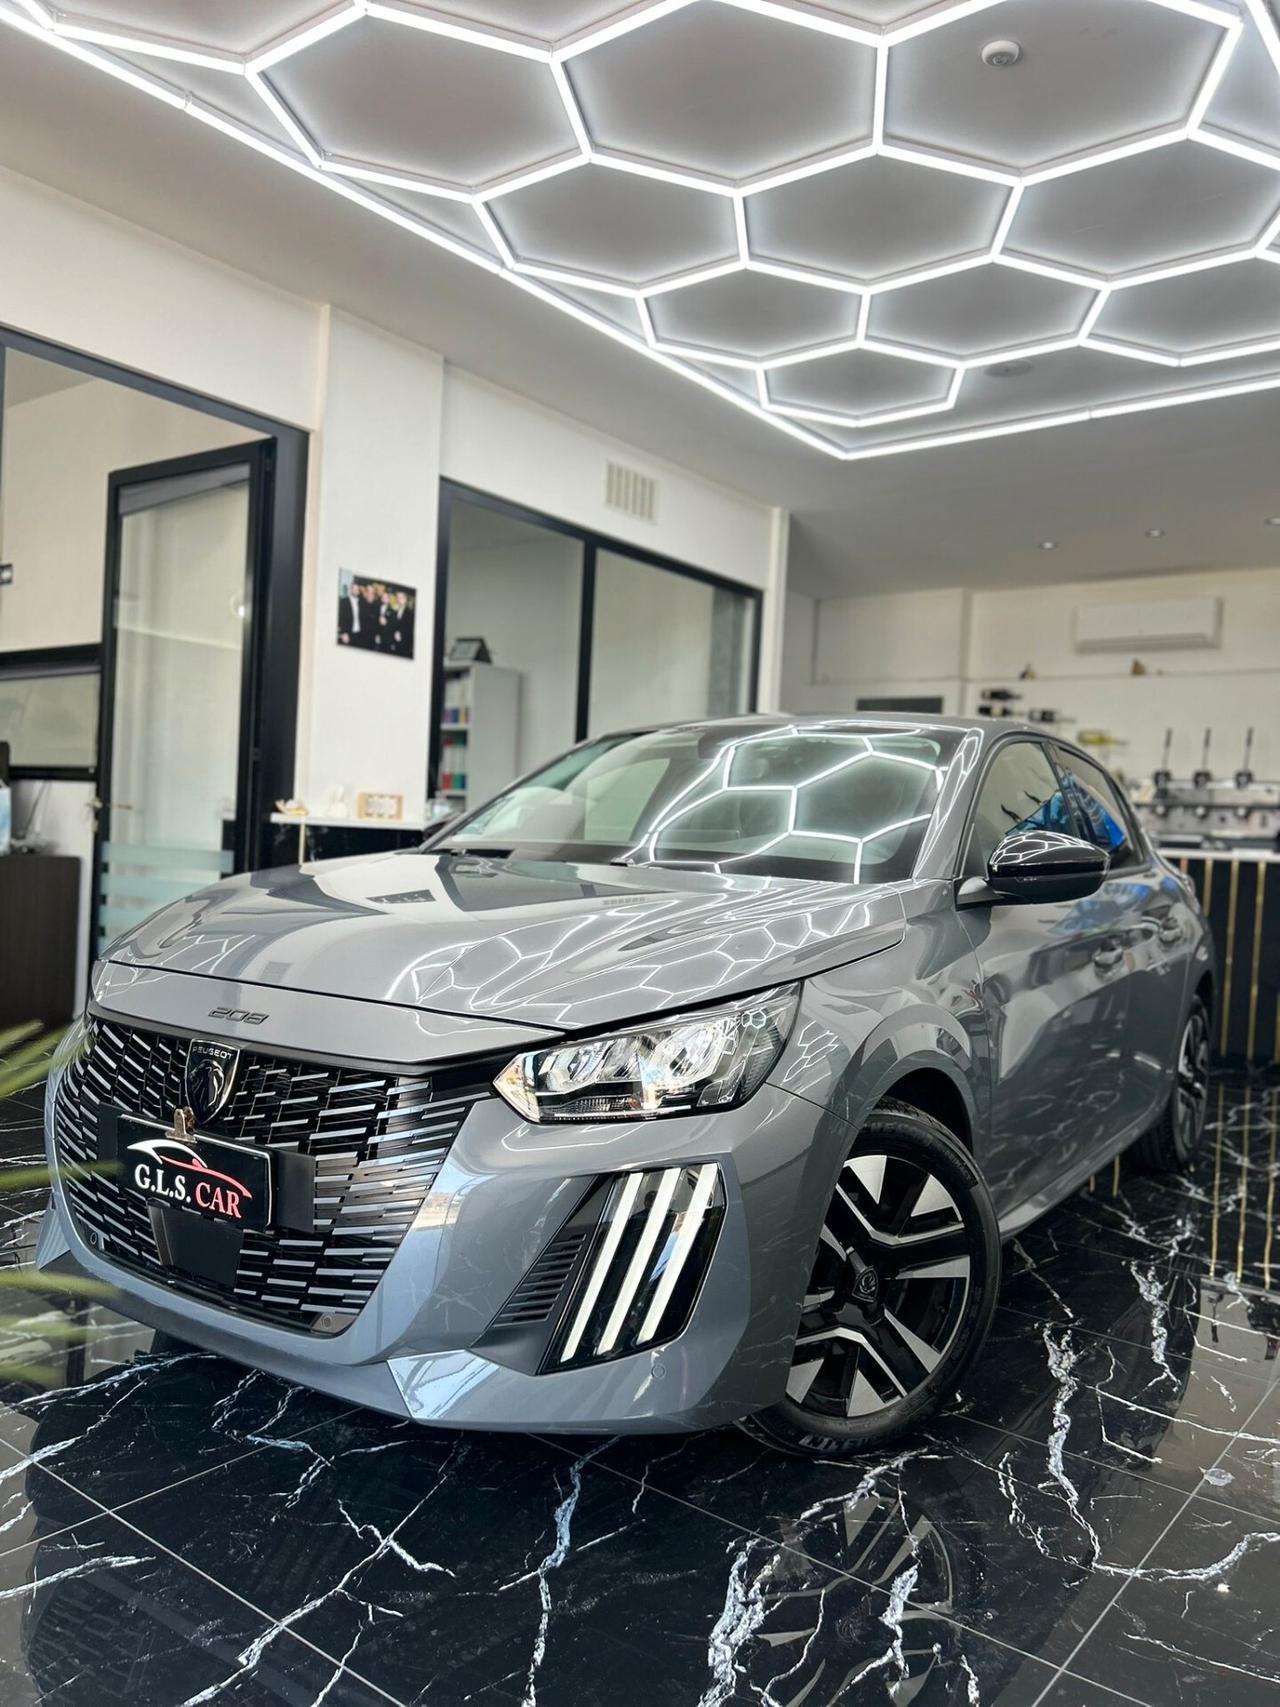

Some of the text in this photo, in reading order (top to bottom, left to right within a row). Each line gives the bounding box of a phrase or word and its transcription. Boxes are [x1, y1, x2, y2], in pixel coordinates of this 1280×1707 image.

[207, 1006, 269, 1025] 208
[192, 1045, 234, 1060] PEUGEOT
[134, 1163, 242, 1219] G.L.S. CAR
